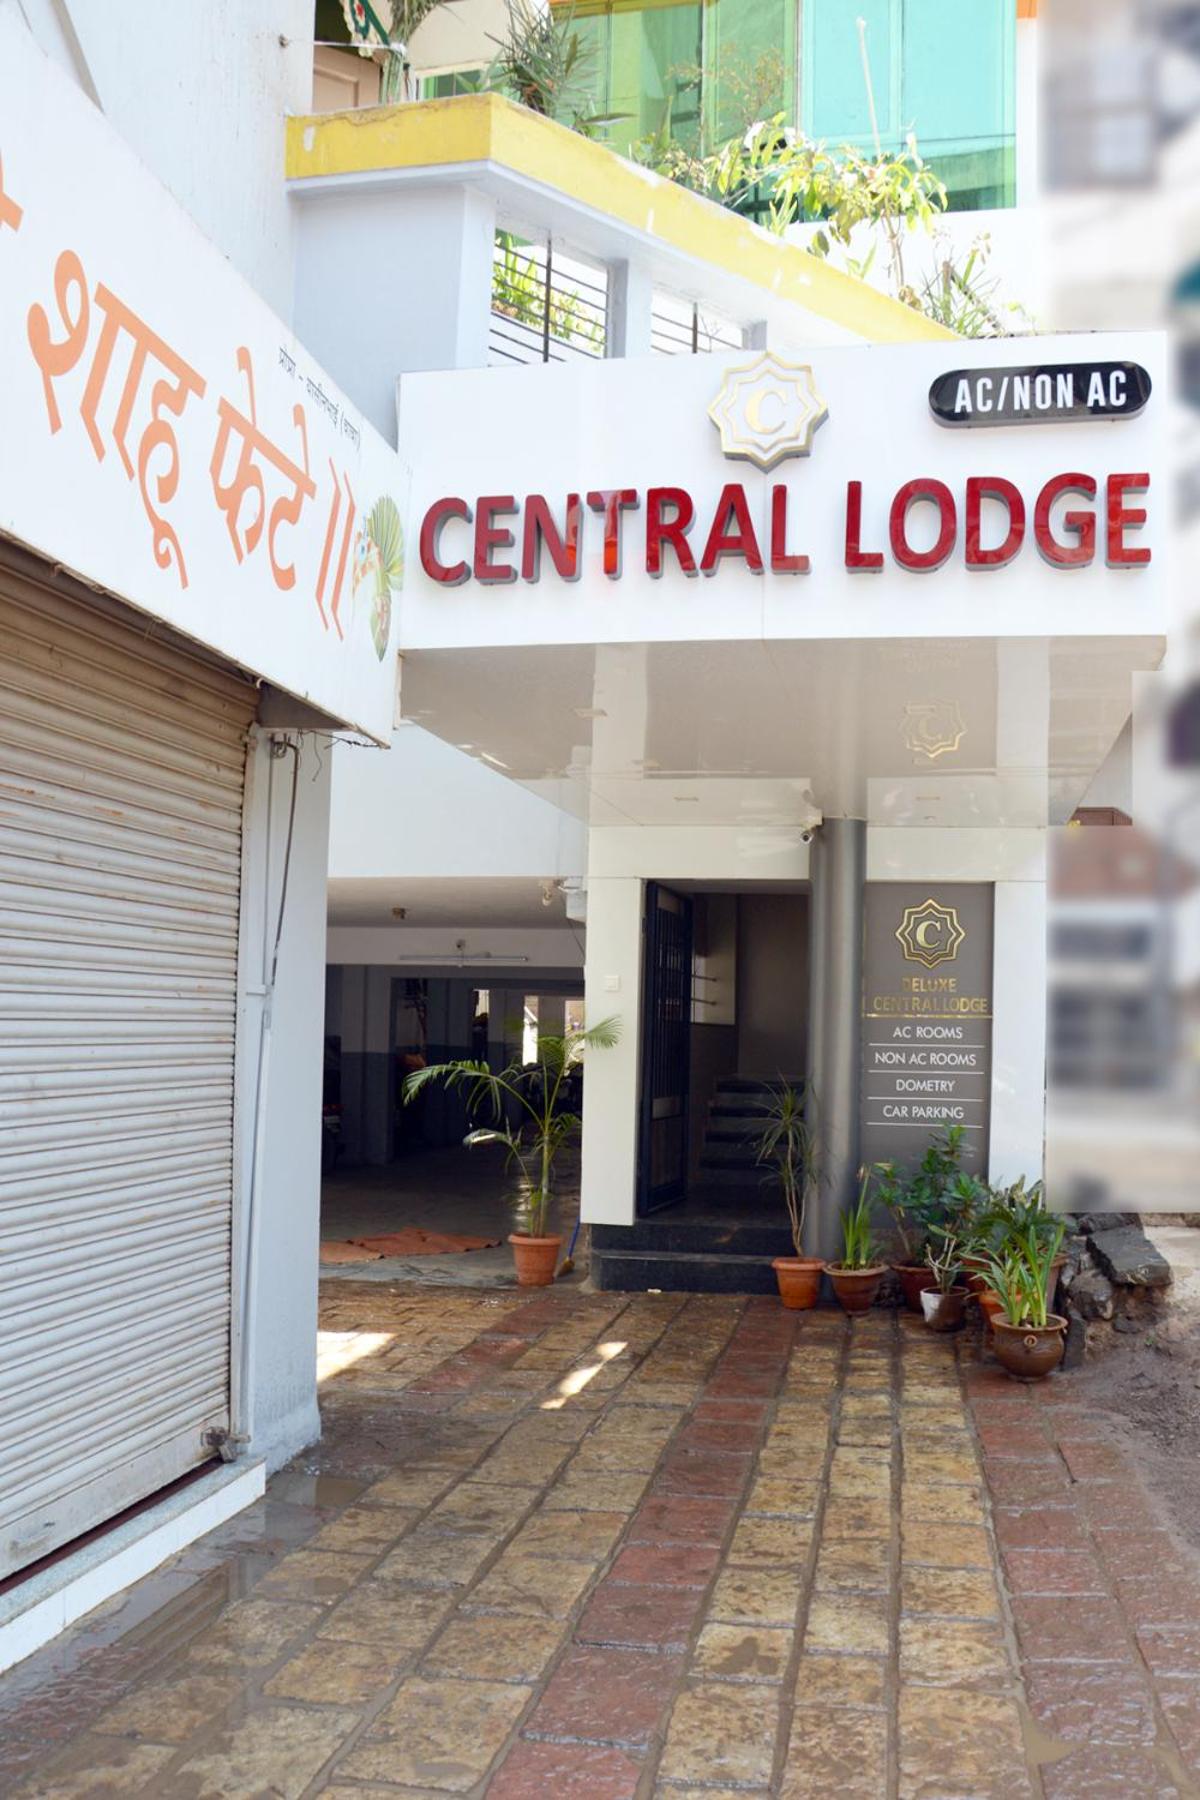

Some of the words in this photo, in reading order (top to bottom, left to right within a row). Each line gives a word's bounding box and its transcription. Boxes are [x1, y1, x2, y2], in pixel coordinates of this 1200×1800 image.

[954, 373, 1074, 414] AC/NON
[1087, 370, 1128, 408] AC
[419, 482, 811, 588] CENTRAL
[844, 473, 1151, 575] LODGE
[915, 920, 942, 949] C
[902, 977, 957, 993] DELUXE
[873, 996, 940, 1012] CENTRAL
[943, 997, 988, 1013] LODGE
[893, 1026, 912, 1039] AC
[916, 1027, 963, 1040] ROOMS
[875, 1052, 906, 1065] NON
[910, 1053, 927, 1065] AC
[930, 1053, 976, 1066] ROOMS
[896, 1079, 956, 1093] DOMETRY
[883, 1105, 909, 1118] CAR
[912, 1106, 964, 1120] PARKING
